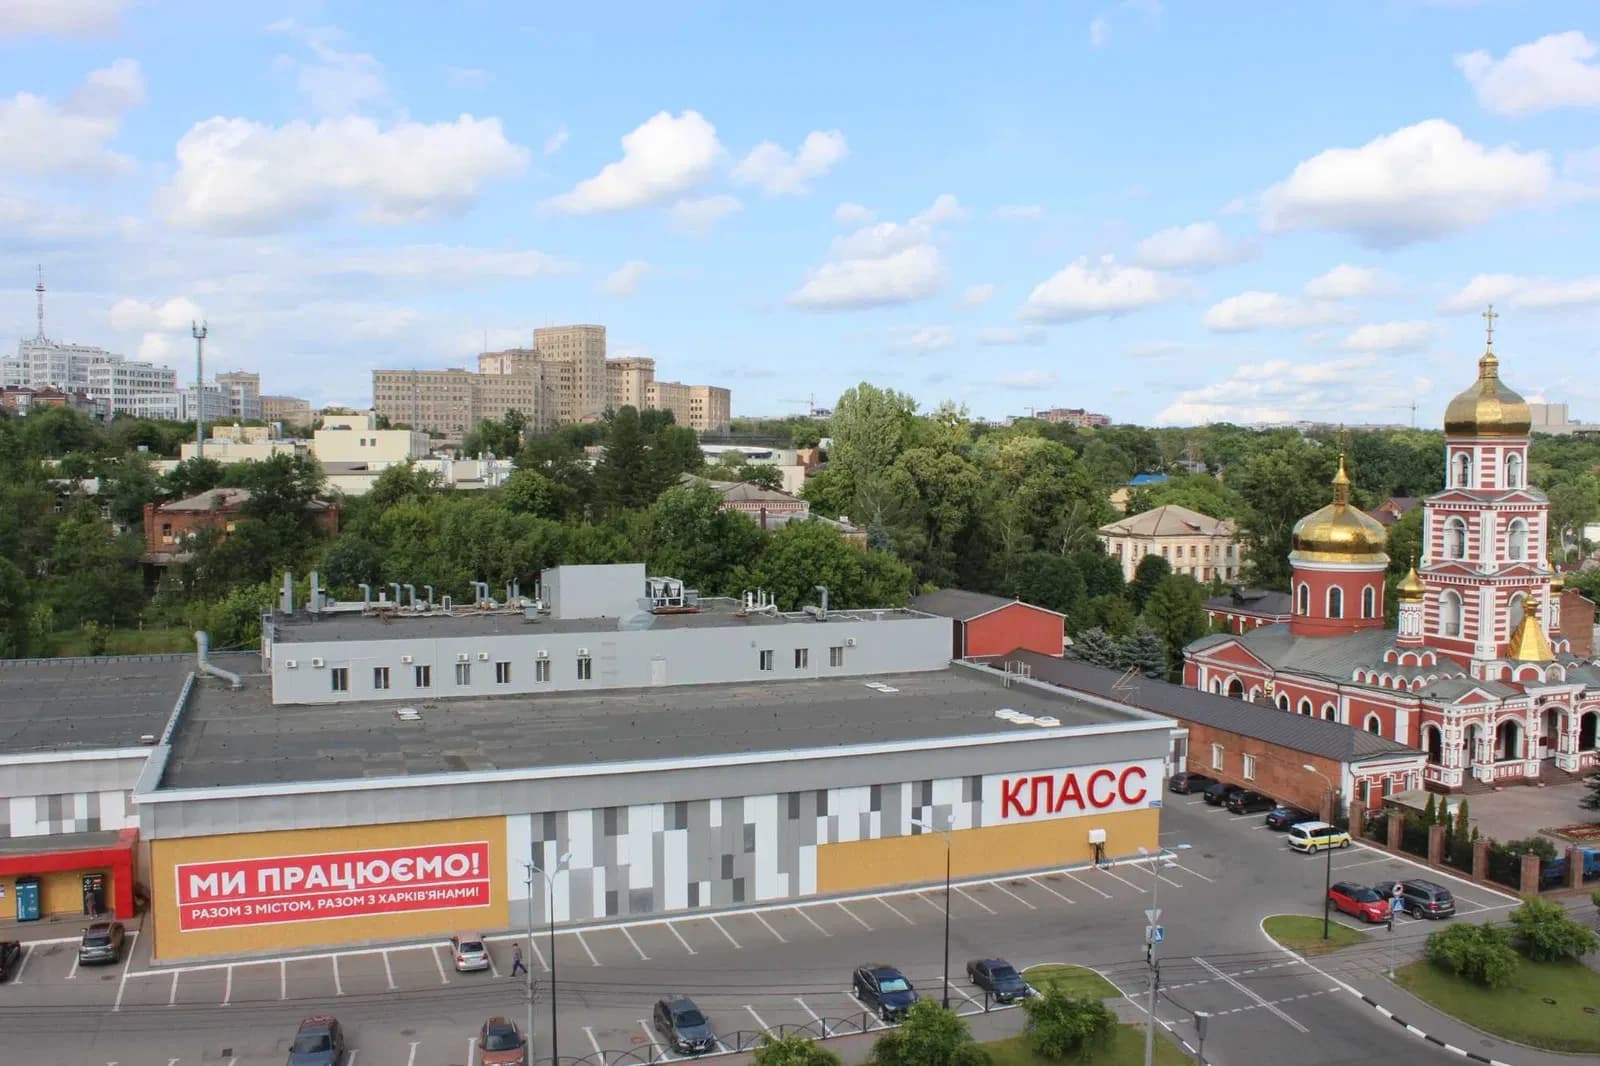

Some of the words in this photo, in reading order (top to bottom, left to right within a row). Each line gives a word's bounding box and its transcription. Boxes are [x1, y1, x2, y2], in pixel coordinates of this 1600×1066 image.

[1001, 766, 1147, 818] КЛАСС
[190, 870, 247, 898] МИ
[258, 853, 479, 890] ПРАЦЮЄМО!
[192, 906, 241, 920] РАЗОМ
[243, 905, 252, 915] З
[255, 900, 314, 914] МІСТОМ,
[317, 895, 365, 909] РАЗОМ
[367, 894, 376, 905] З
[378, 886, 479, 904] ХАРКІВ'ЯНАМИ!
